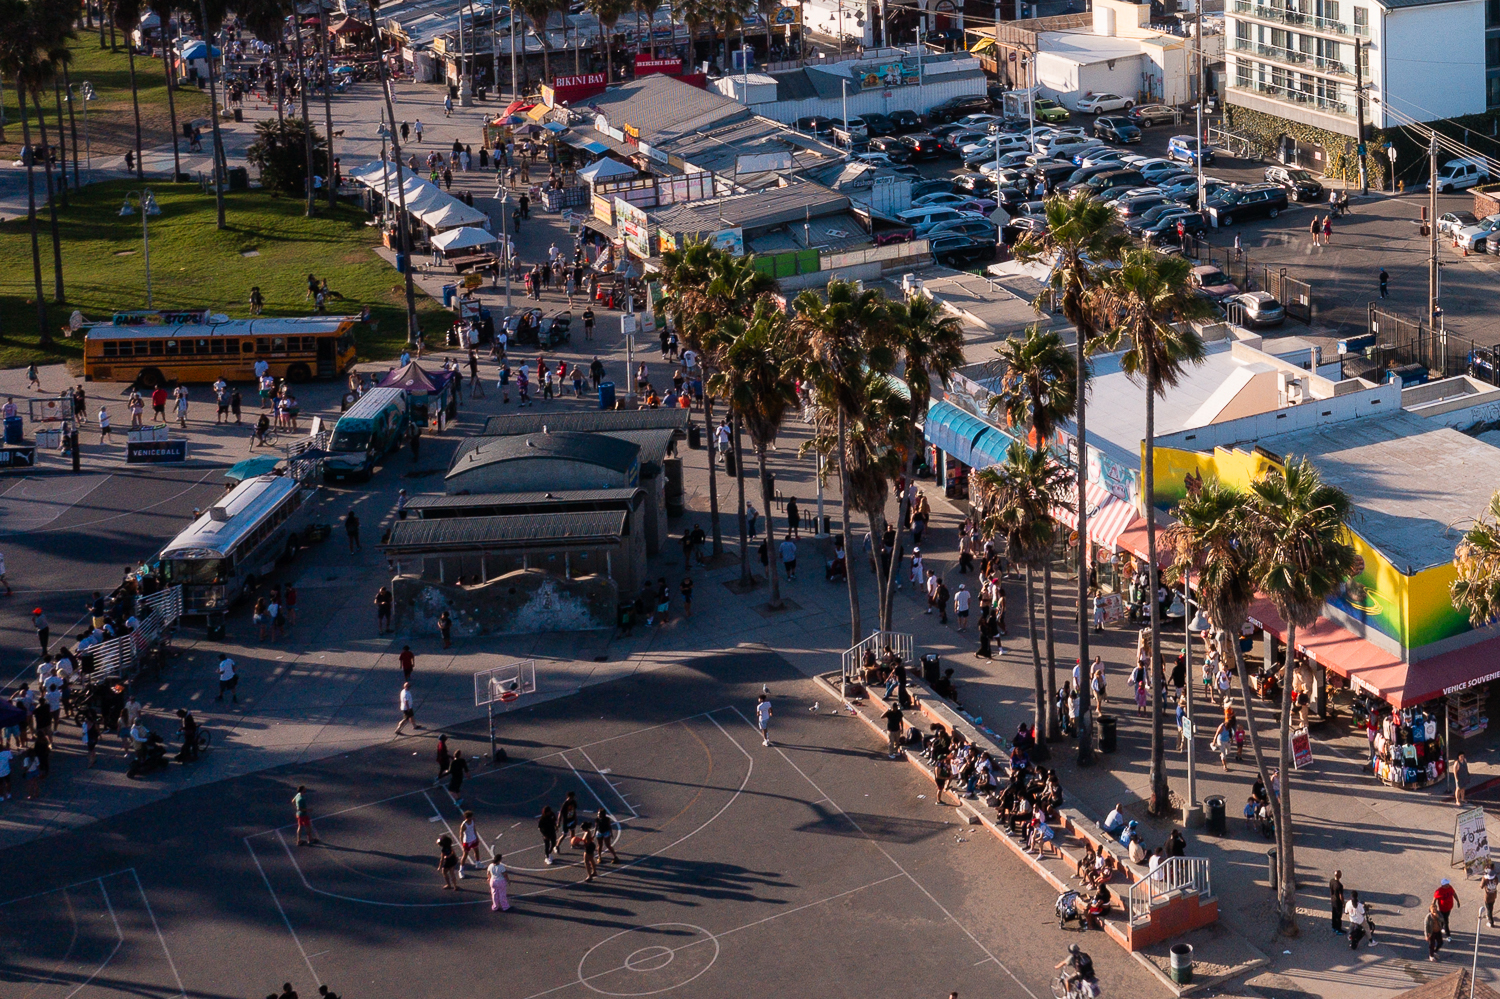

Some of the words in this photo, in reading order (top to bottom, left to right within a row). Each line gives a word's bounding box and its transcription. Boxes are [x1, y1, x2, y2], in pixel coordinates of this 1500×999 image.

[664, 58, 682, 66] BAY
[556, 75, 586, 88] BIKINI
[588, 73, 605, 85] BAY
[132, 448, 181, 456] VENICEBALL
[1442, 681, 1467, 696] VENICE
